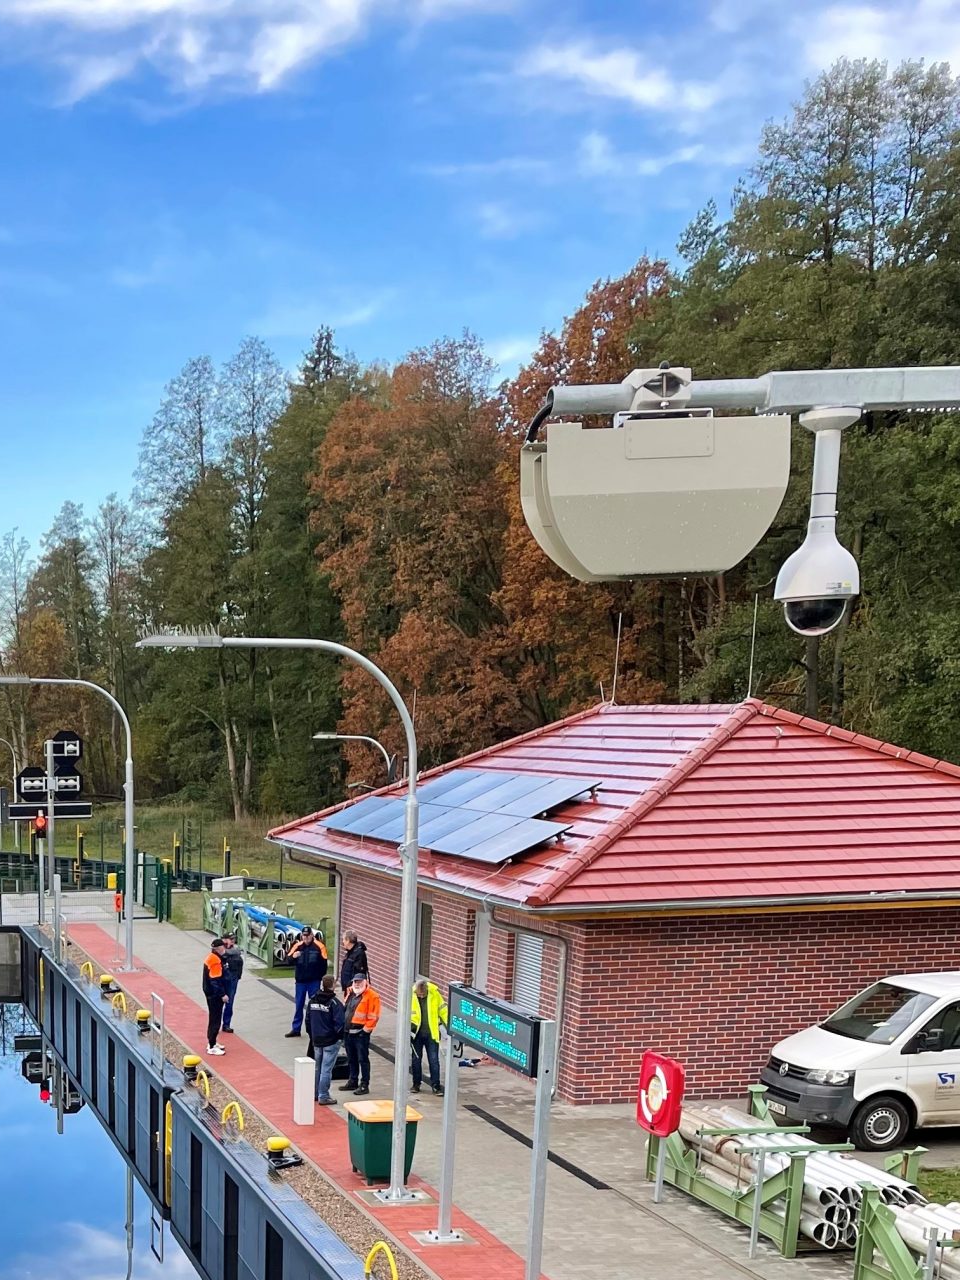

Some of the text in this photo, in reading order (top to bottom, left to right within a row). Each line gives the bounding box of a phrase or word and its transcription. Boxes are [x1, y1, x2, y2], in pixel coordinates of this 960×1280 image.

[451, 1015, 527, 1067] Schleuse Kannenburg
[476, 1007, 516, 1036] Oder-Havel
